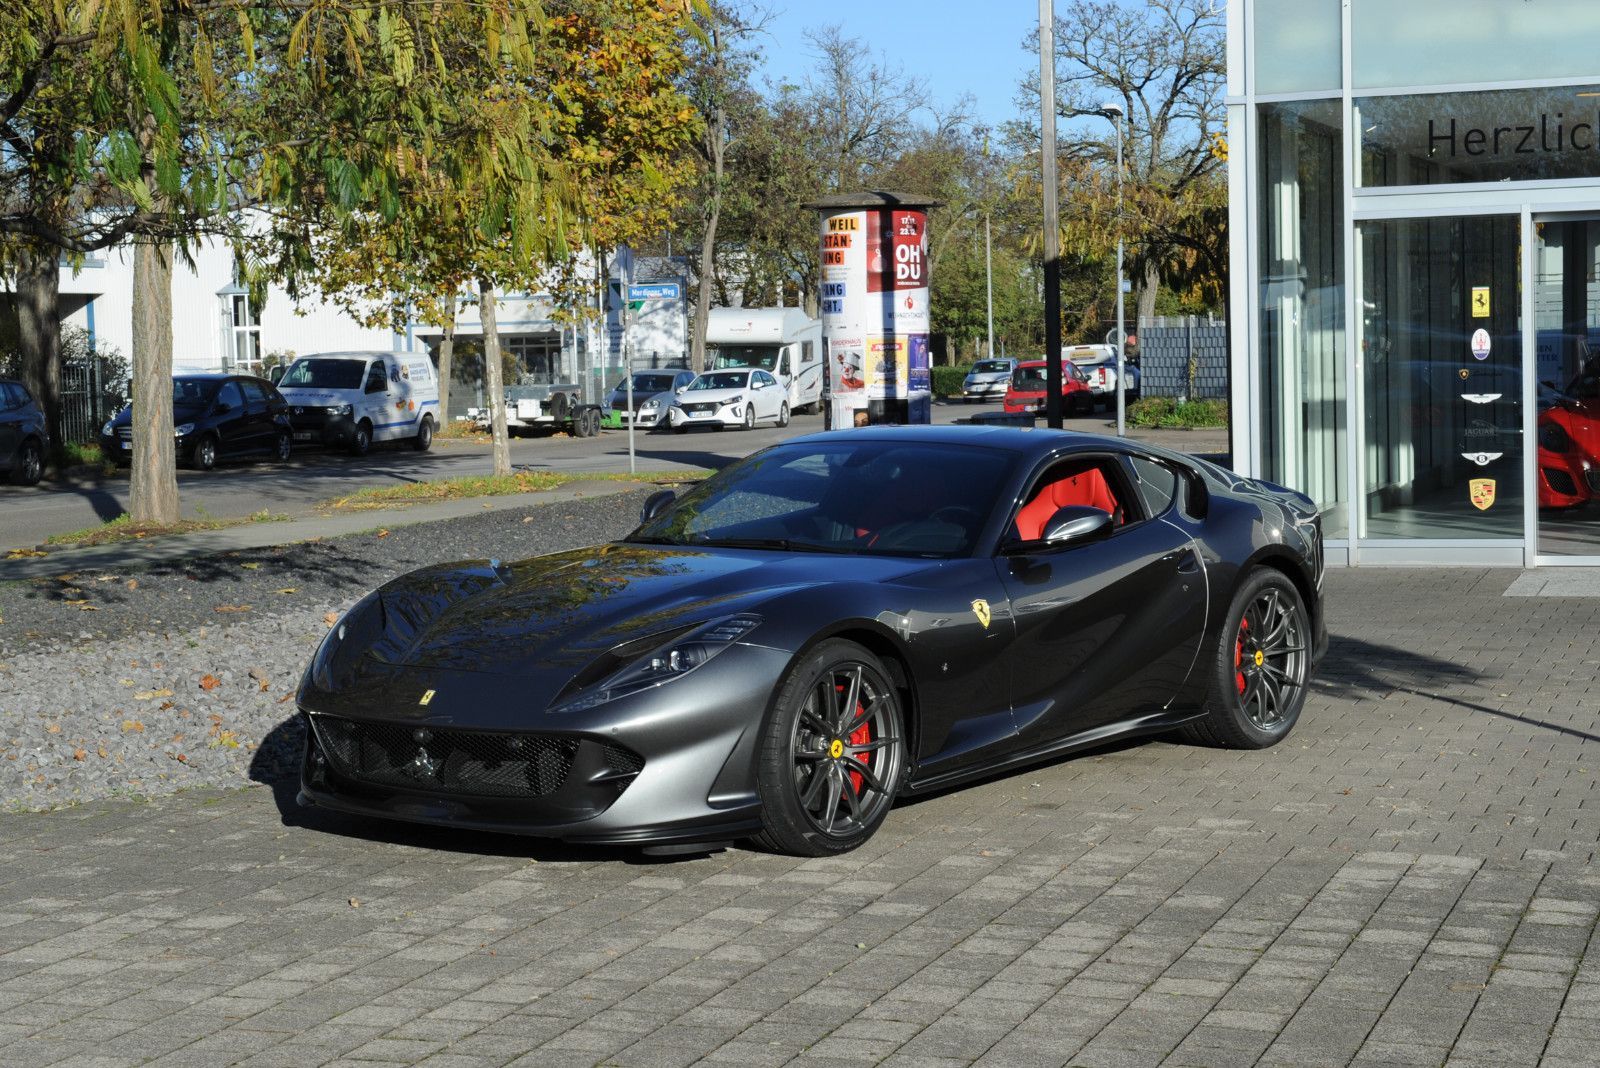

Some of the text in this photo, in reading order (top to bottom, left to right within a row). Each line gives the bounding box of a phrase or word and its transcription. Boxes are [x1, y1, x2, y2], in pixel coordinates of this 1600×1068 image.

[829, 218, 856, 231] WEIL
[895, 244, 920, 263] OH
[896, 263, 921, 280] DU
